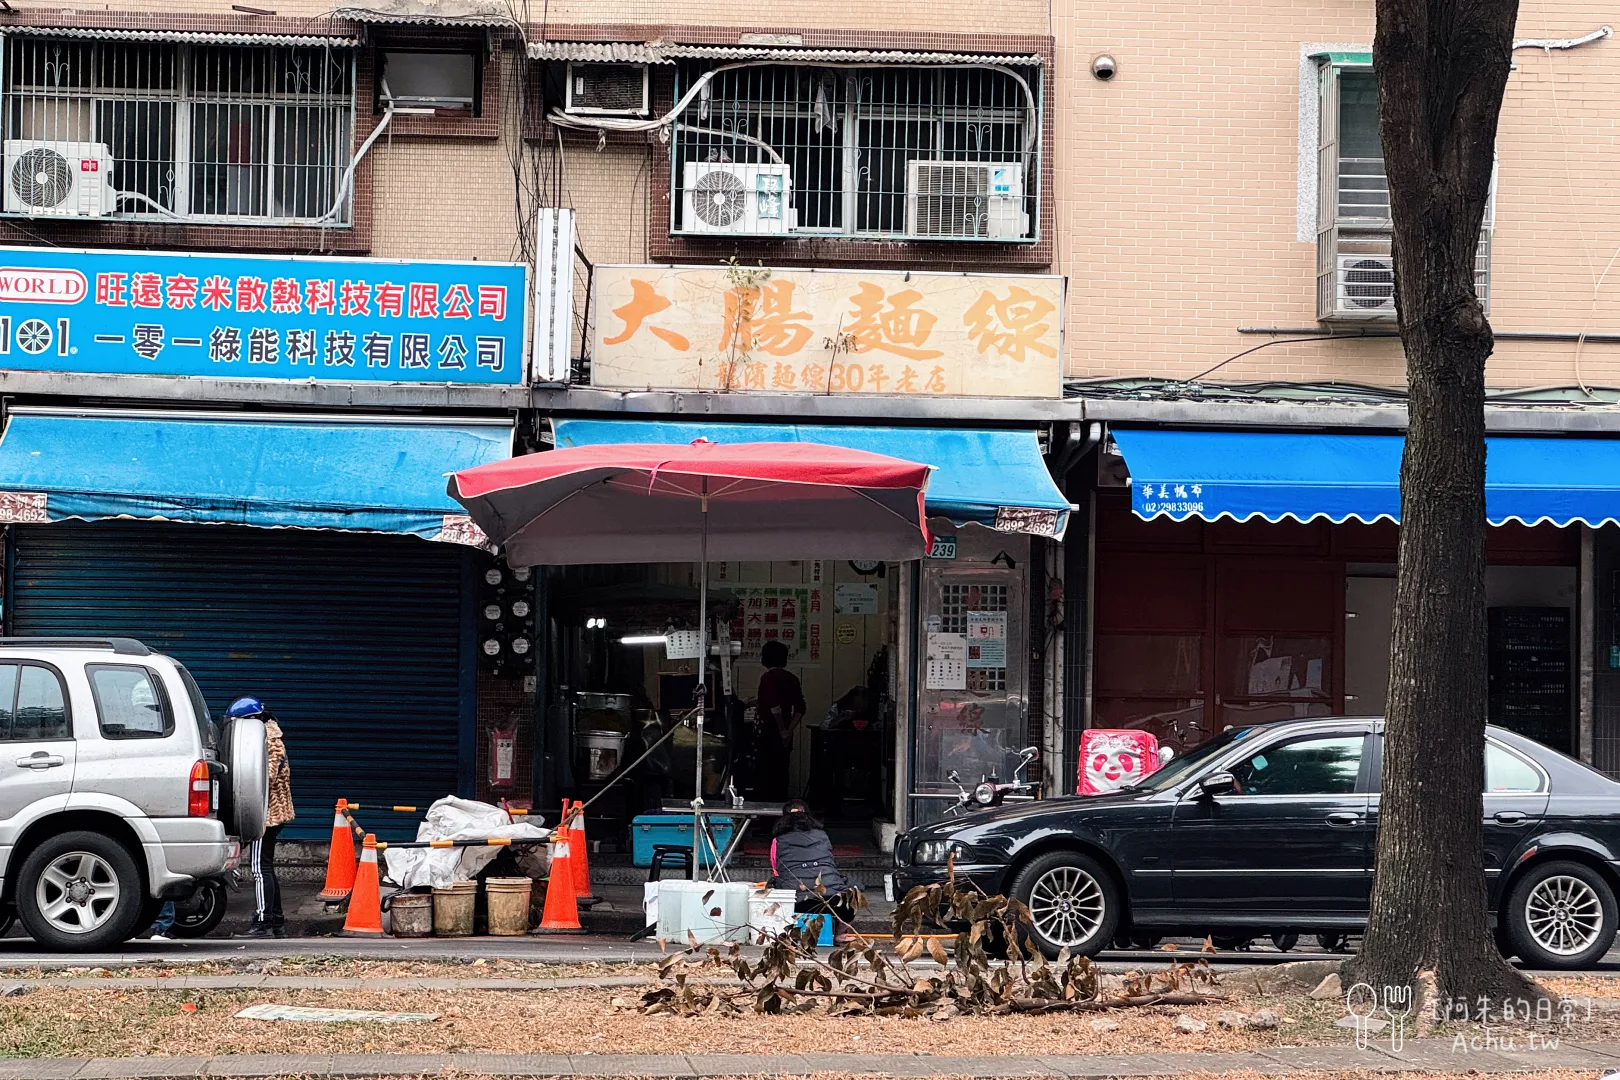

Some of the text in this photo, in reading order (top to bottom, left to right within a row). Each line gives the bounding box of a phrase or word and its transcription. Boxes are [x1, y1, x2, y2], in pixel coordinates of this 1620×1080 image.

[0, 276, 80, 295] WORLD
[96, 272, 508, 320] 旺遠奈米散熱科技有限公司
[603, 279, 1059, 362] 大腸麵線
[94, 323, 506, 372] 一零一綠能科技有限公司
[1142, 484, 1203, 499] 華美帆布
[932, 544, 954, 557] 239
